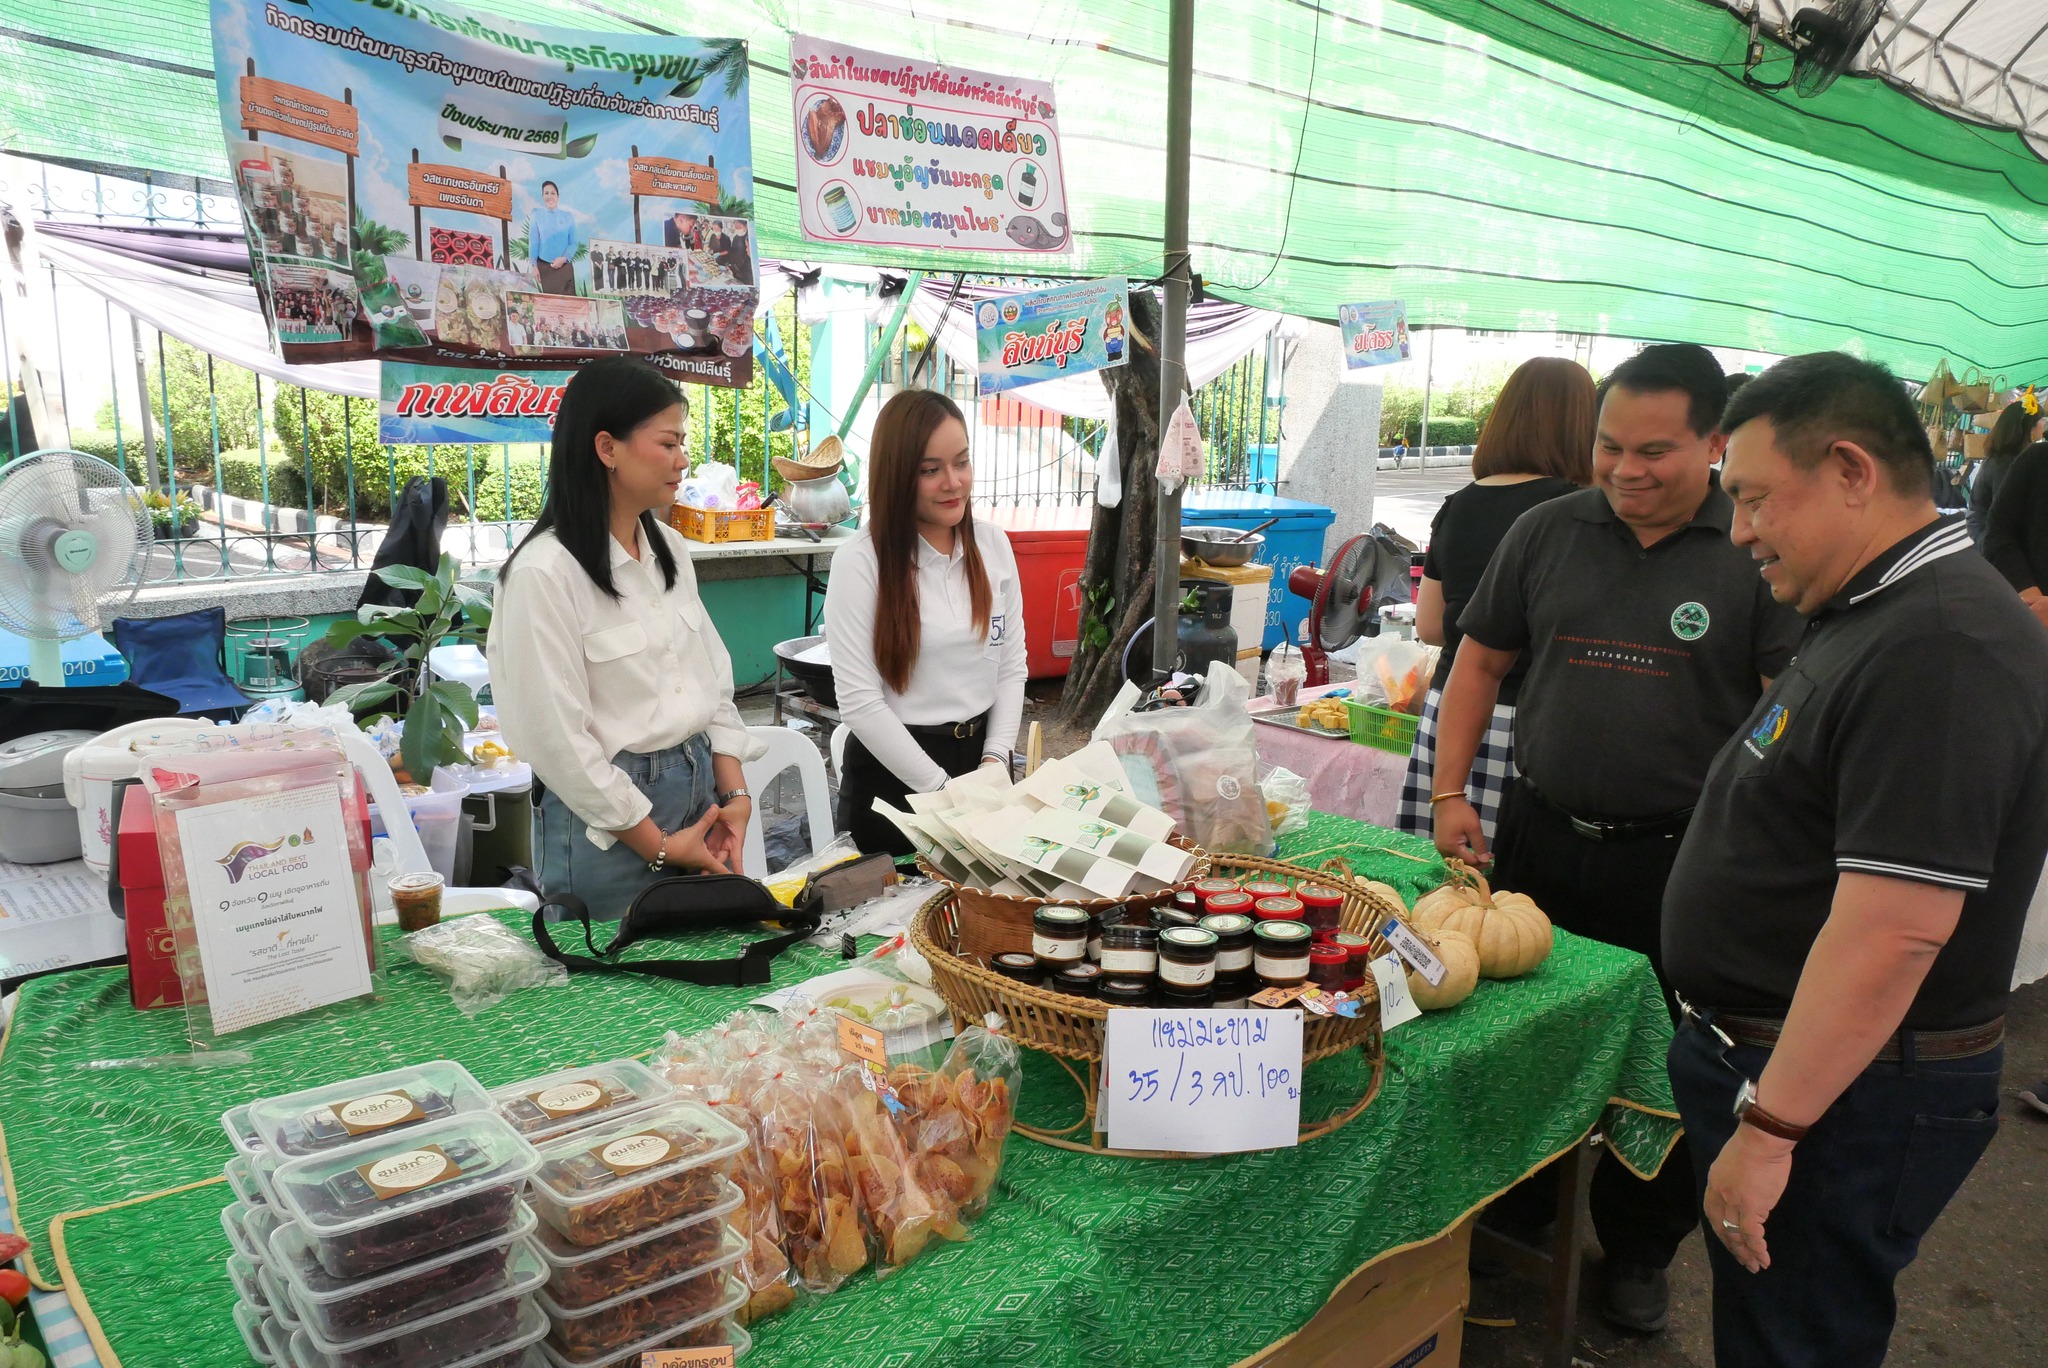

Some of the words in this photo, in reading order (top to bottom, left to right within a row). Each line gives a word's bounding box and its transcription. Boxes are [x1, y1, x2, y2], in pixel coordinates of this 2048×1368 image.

[265, 4, 720, 133] กิจกรรมพัฒนาธุรกิจชุมชนในเขตปฏิรูปที่ดินจังหวัดกาฬสินธุ์
[809, 55, 1037, 120] สินค้าในเขตปฏิรูปที่ดินจังหวัดสิงห์บุรี
[442, 102, 522, 141] ปีงบประมาณ
[523, 128, 560, 146] 2569
[856, 103, 1047, 156] ปลาช่อนแดดเดียว
[423, 173, 499, 194] วสช.เกษตรอินทรีย์
[853, 155, 1004, 199] แชมพูอัญชันมะกรูด
[439, 192, 484, 208] เพชรจินดา
[866, 202, 998, 237] ยาหม่องสมุนไพร
[1003, 317, 1088, 368] สิงห์บุรี
[1587, 650, 1653, 664] CATAMARAN
[248, 858, 287, 872] THAILAND
[289, 855, 306, 863] BEST
[249, 869, 280, 880] LOCAL
[282, 861, 308, 873] FOOD
[1152, 1016, 1268, 1048] แยมมะขาม
